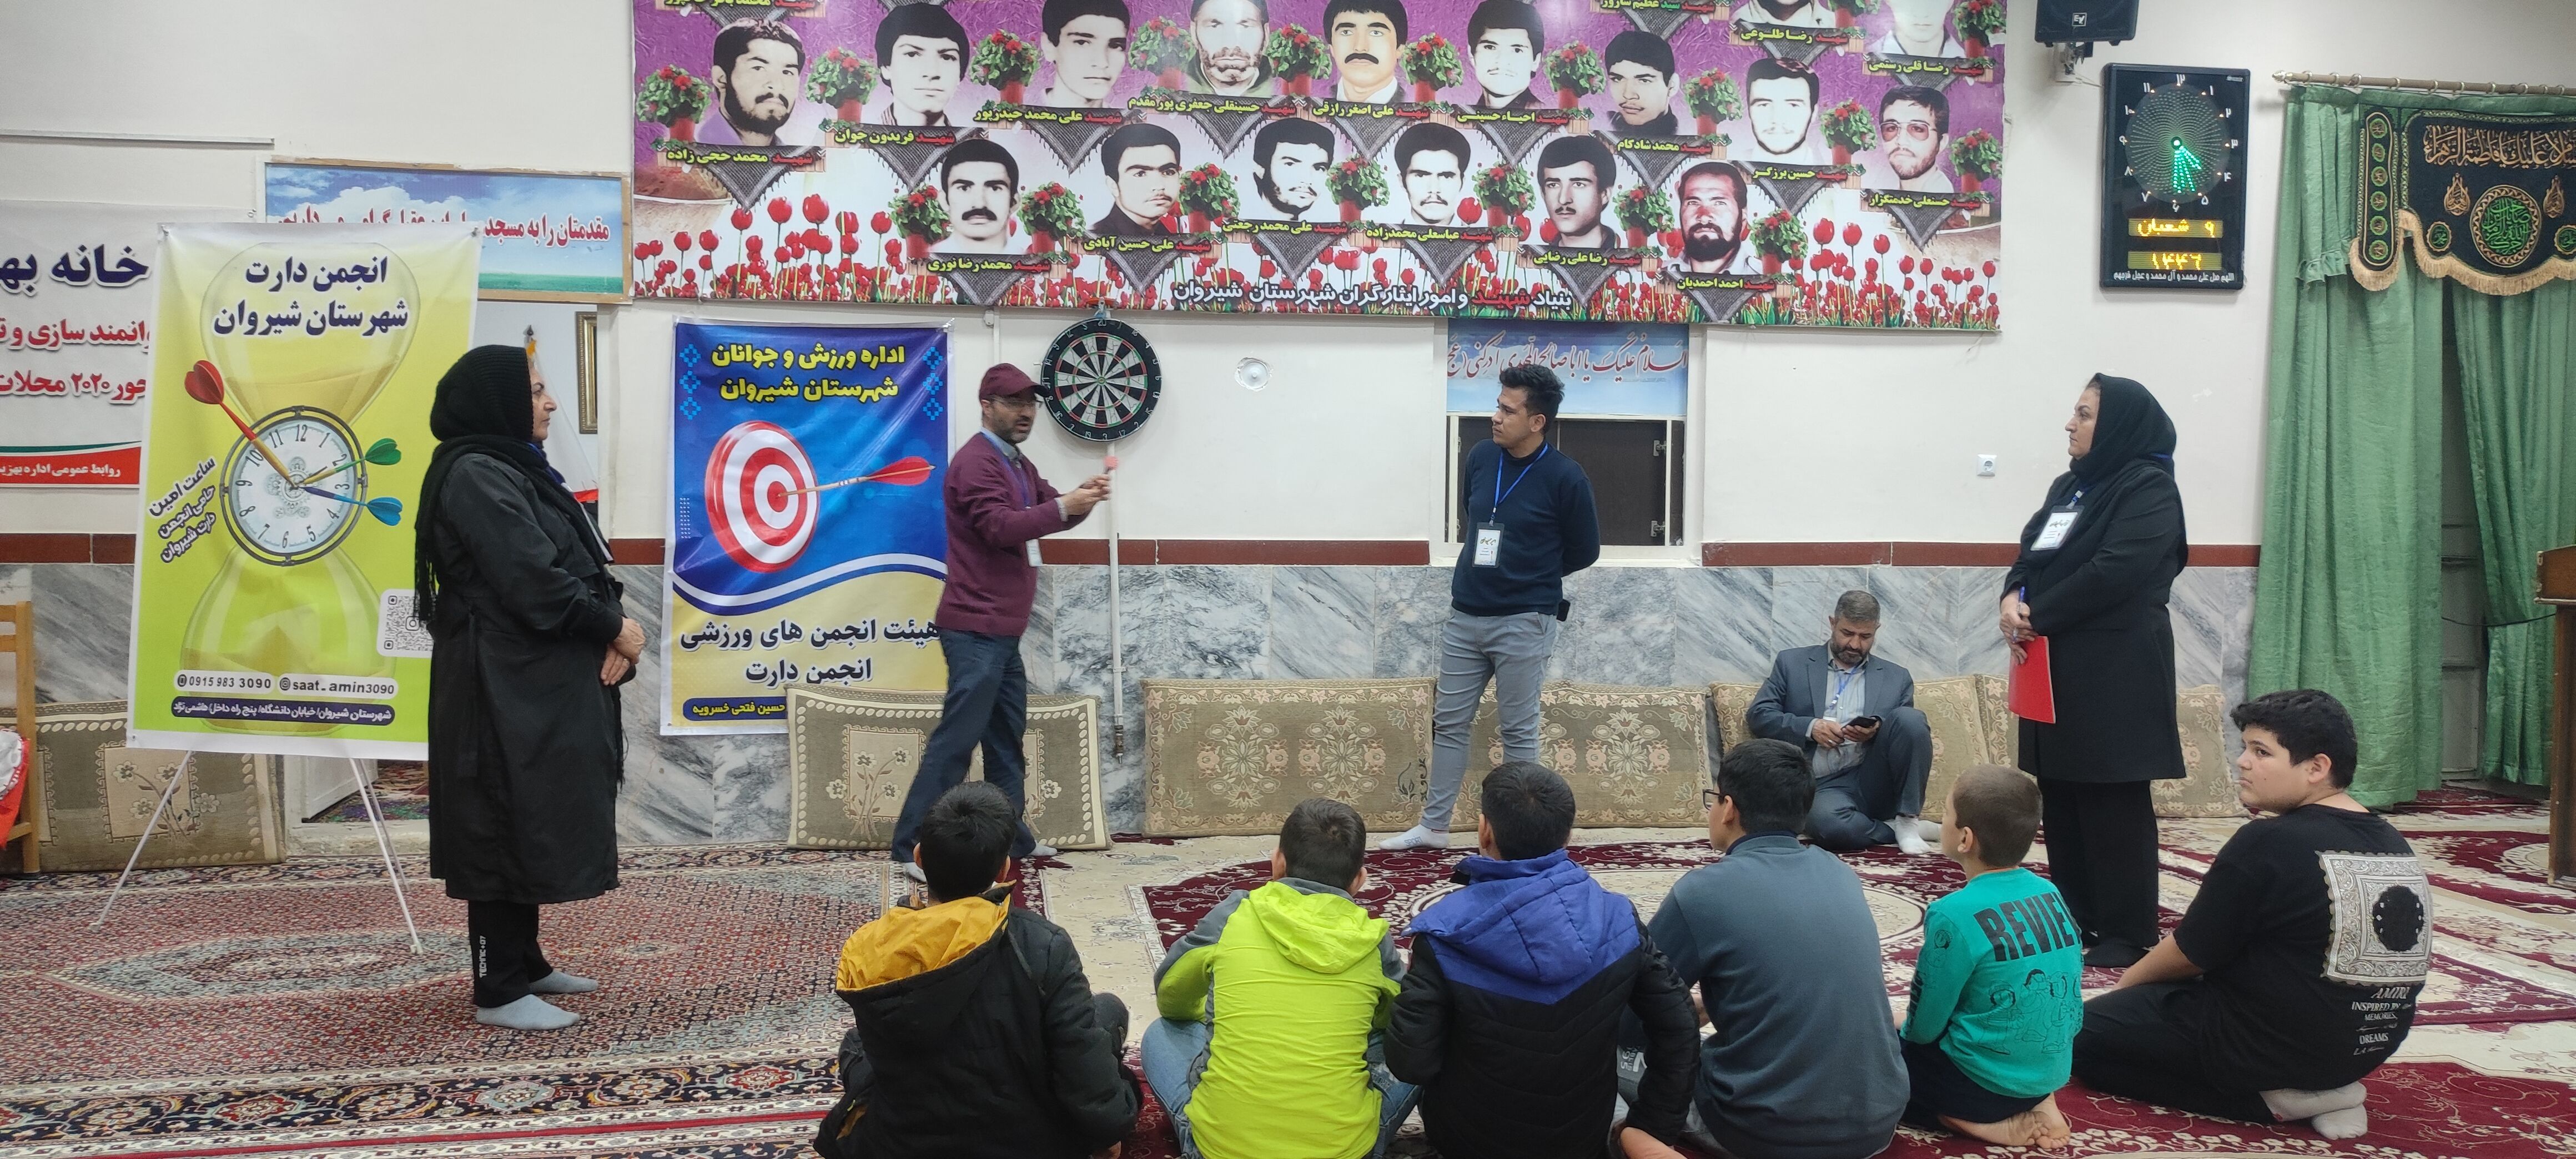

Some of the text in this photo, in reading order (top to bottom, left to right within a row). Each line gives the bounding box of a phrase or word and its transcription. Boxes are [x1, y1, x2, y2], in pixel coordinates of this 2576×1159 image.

[1741, 28, 1784, 41] طلوعی
[1785, 29, 1812, 43] رضا
[1869, 61, 1902, 72] رستمی
[1903, 59, 1922, 73] قلی
[1924, 61, 1949, 74] رضا
[1128, 97, 1156, 109] مقدم
[1175, 99, 1212, 112] جعفری
[1214, 100, 1260, 113] حسینقلی
[1025, 111, 1057, 120] محمد
[1059, 110, 1083, 123] علی
[1346, 104, 1371, 116] اصغر
[1372, 105, 1394, 118] علی
[1457, 111, 1500, 122] حسینی
[834, 128, 867, 143] جوان
[869, 130, 914, 144] فریدون
[1652, 143, 1679, 151] محمد
[667, 149, 695, 163] زاده
[697, 155, 731, 164] حجی
[733, 153, 768, 162] محمد
[1788, 170, 1815, 180] حسین
[485, 213, 609, 246] مقدمتان را به مسجد
[1291, 220, 1312, 234] علی
[2137, 218, 2190, 236] شعبان
[1418, 228, 1460, 241] عباسعلی
[1084, 236, 1116, 250] آبادی
[1118, 240, 1150, 251] حسین
[1152, 239, 1174, 252] علی
[51, 244, 149, 283] خانه
[1533, 251, 1566, 264] رضایی
[1567, 253, 1588, 264] علی
[1589, 253, 1607, 265] رضا
[928, 258, 956, 271] نوری
[958, 258, 979, 271] رضا
[980, 261, 1012, 269] محمد
[246, 256, 388, 292] انجمن دارت
[1677, 278, 1717, 289] احمدیان
[1718, 278, 1743, 288] احمد
[1174, 281, 1243, 302] شیروان
[1249, 284, 1336, 305] شهرستان
[1419, 289, 1455, 309] امور
[1457, 294, 1467, 309] و
[1472, 289, 1531, 309] شهید
[1533, 290, 1572, 310] بنیاد
[214, 299, 407, 336] شهرستان شیروان
[11, 327, 23, 346] و
[28, 319, 84, 347] سازی
[712, 342, 905, 370] اداره ورزش و جوانان
[720, 376, 898, 403] شهرستان شیروان
[24, 463, 121, 477] روابط عمومی اداره
[149, 458, 215, 517] ساعت امین
[159, 486, 215, 538] حامی انجمن
[162, 513, 215, 562] دارت شیروان
[681, 618, 941, 648] هیئت انجمن های ورزشی
[746, 657, 872, 687] انجمن دارت
[189, 675, 271, 689] 0915 983 3090
[230, 704, 242, 715] راه
[242, 706, 257, 717] پنج
[290, 706, 316, 718] خیابان
[349, 708, 392, 722] شهرستان
[731, 702, 756, 715] فتحی
[758, 704, 786, 715] حسین
[1403, 836, 1423, 846] SPORT
[1973, 891, 2081, 962] REVIE
[2370, 986, 2410, 999] AMIRI
[2352, 1001, 2389, 1011] INSPIRED
[2359, 1032, 2389, 1045] DREAMS
